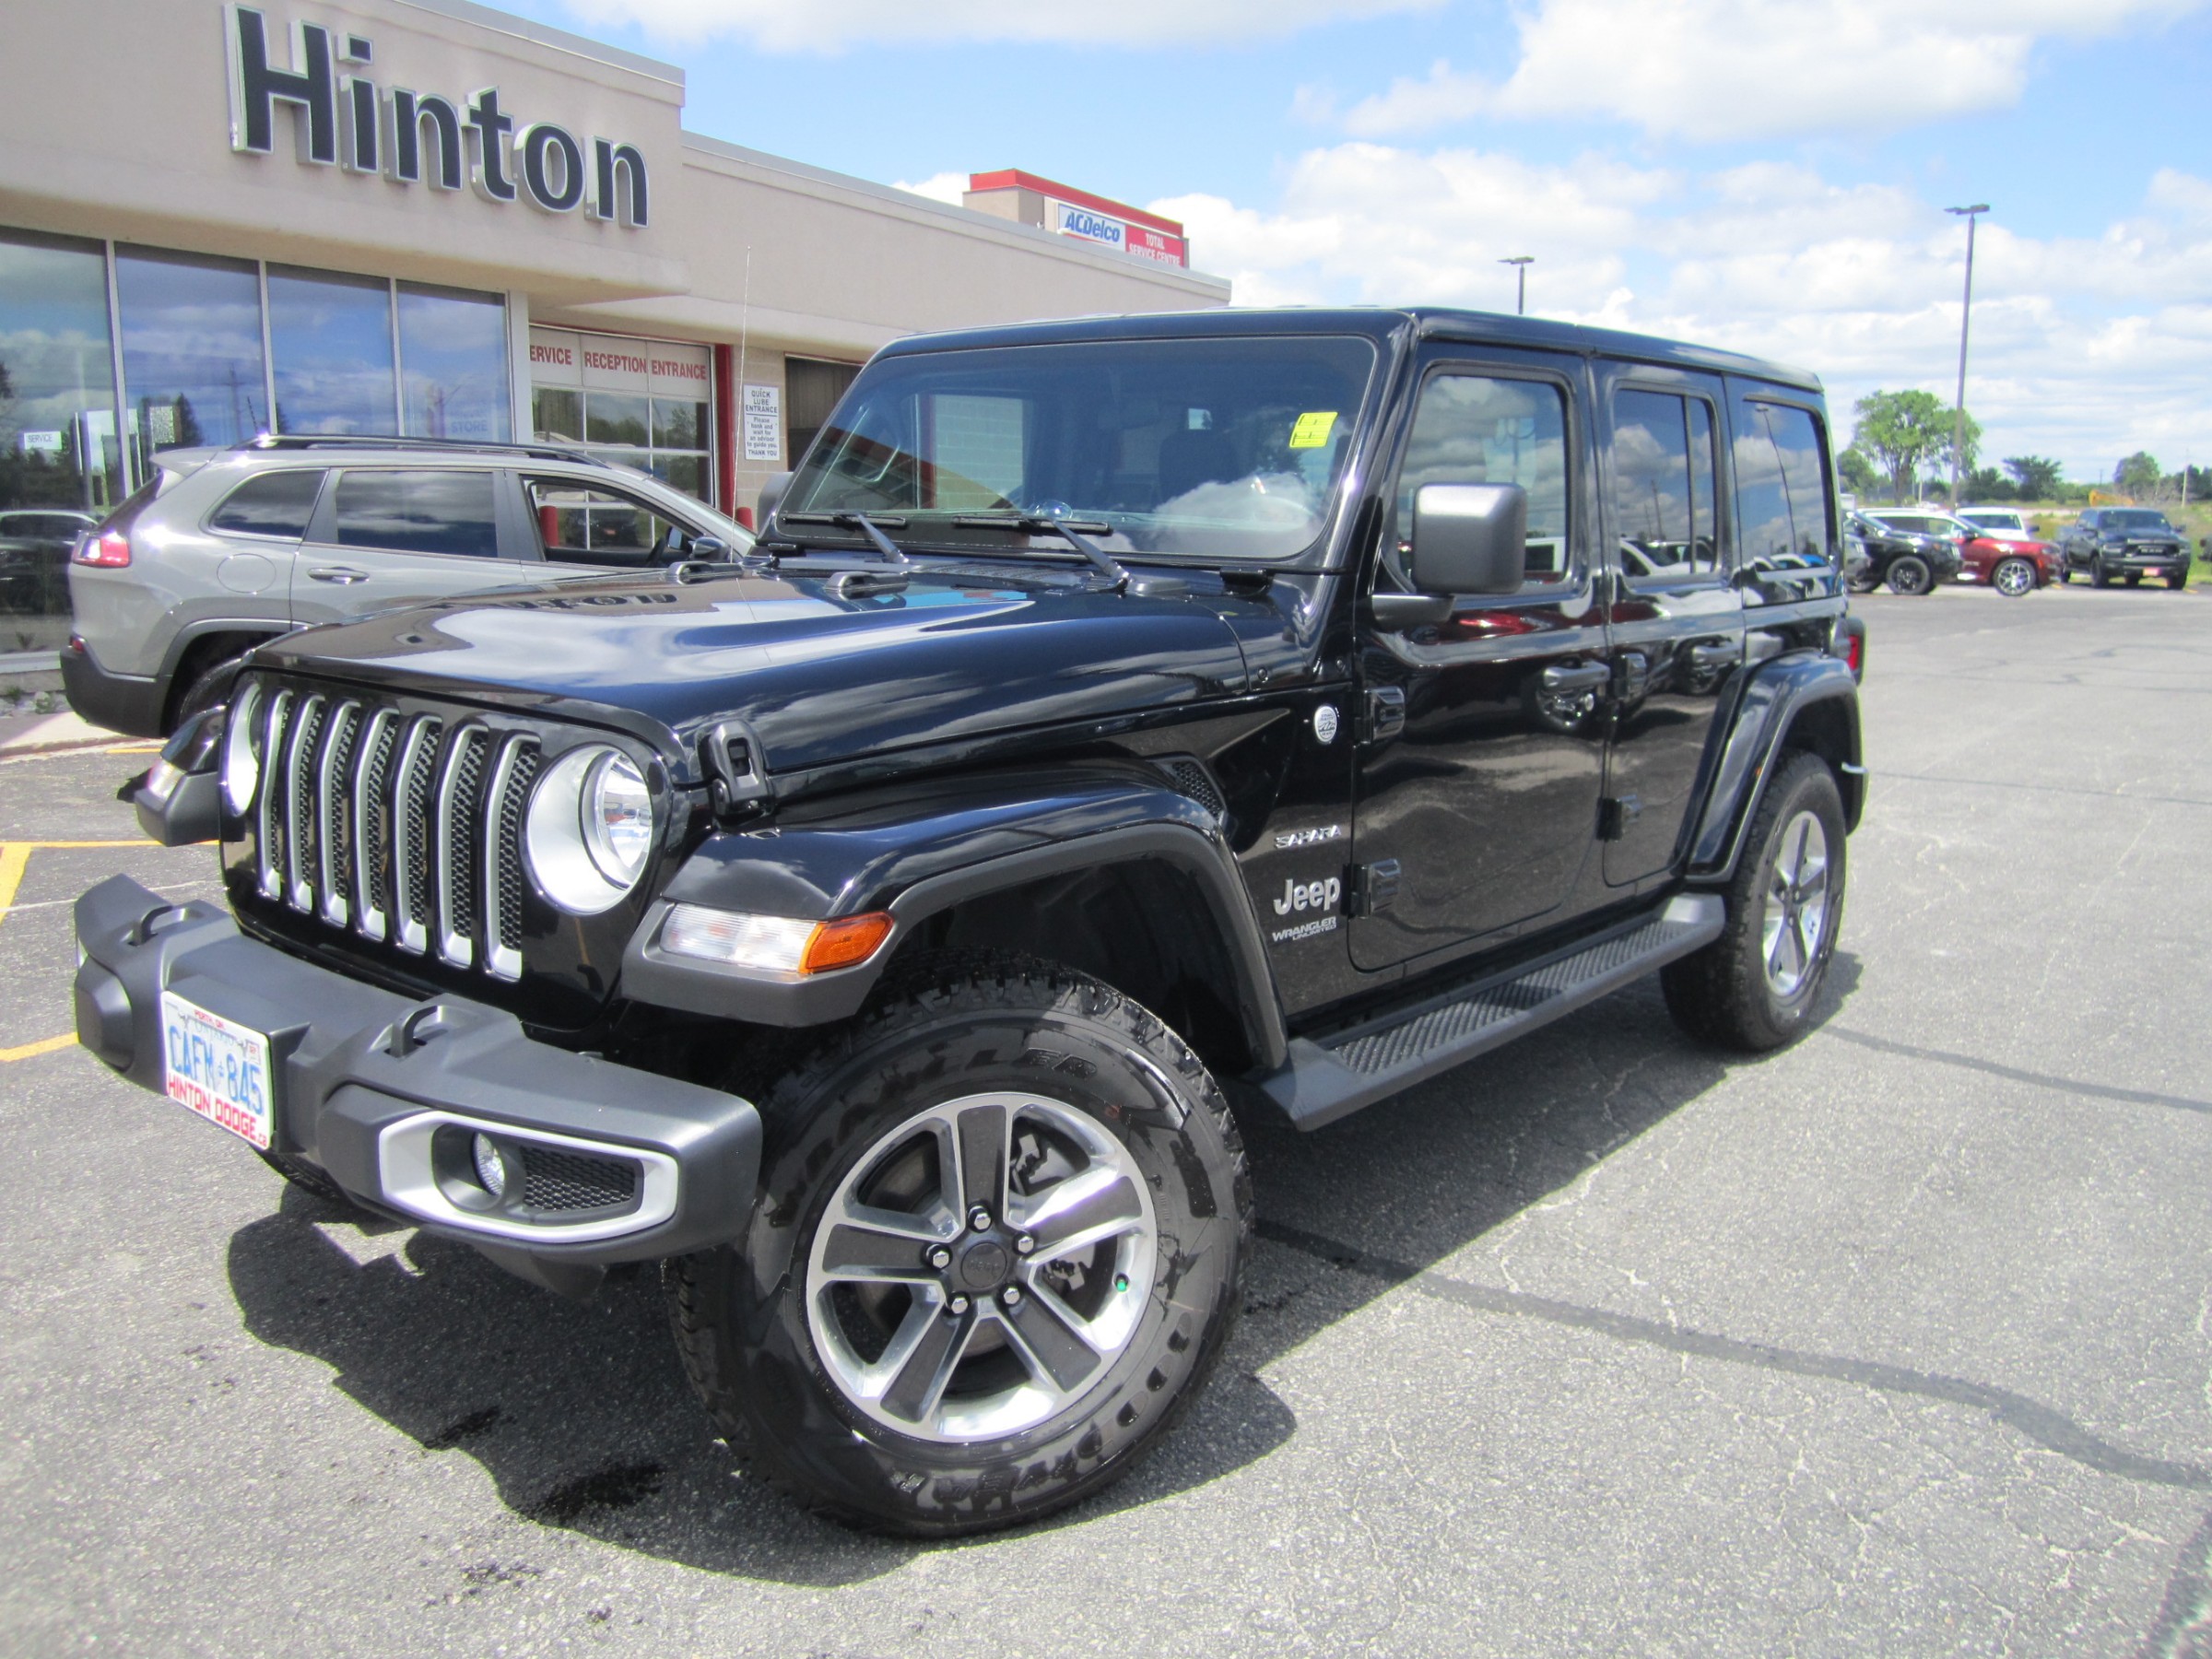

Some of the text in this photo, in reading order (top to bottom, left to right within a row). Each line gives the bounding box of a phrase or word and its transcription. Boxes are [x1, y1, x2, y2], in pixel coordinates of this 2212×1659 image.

[225, 3, 649, 229] Hinton
[1065, 211, 1121, 242] ACDelco
[1129, 242, 1181, 265] SERVICE CENTRE
[1146, 232, 1165, 250] TOTAL
[529, 345, 707, 381] ERVICE RECEPTION ENTRANCE
[745, 405, 778, 414] ENTRANCE
[28, 433, 53, 442] SERVICE
[1275, 824, 1341, 849] SAHARA
[1273, 877, 1341, 915] Jeep
[1272, 916, 1336, 942] WRANGLER
[169, 1074, 212, 1117] HINTON
[215, 1098, 257, 1141] DODGE
